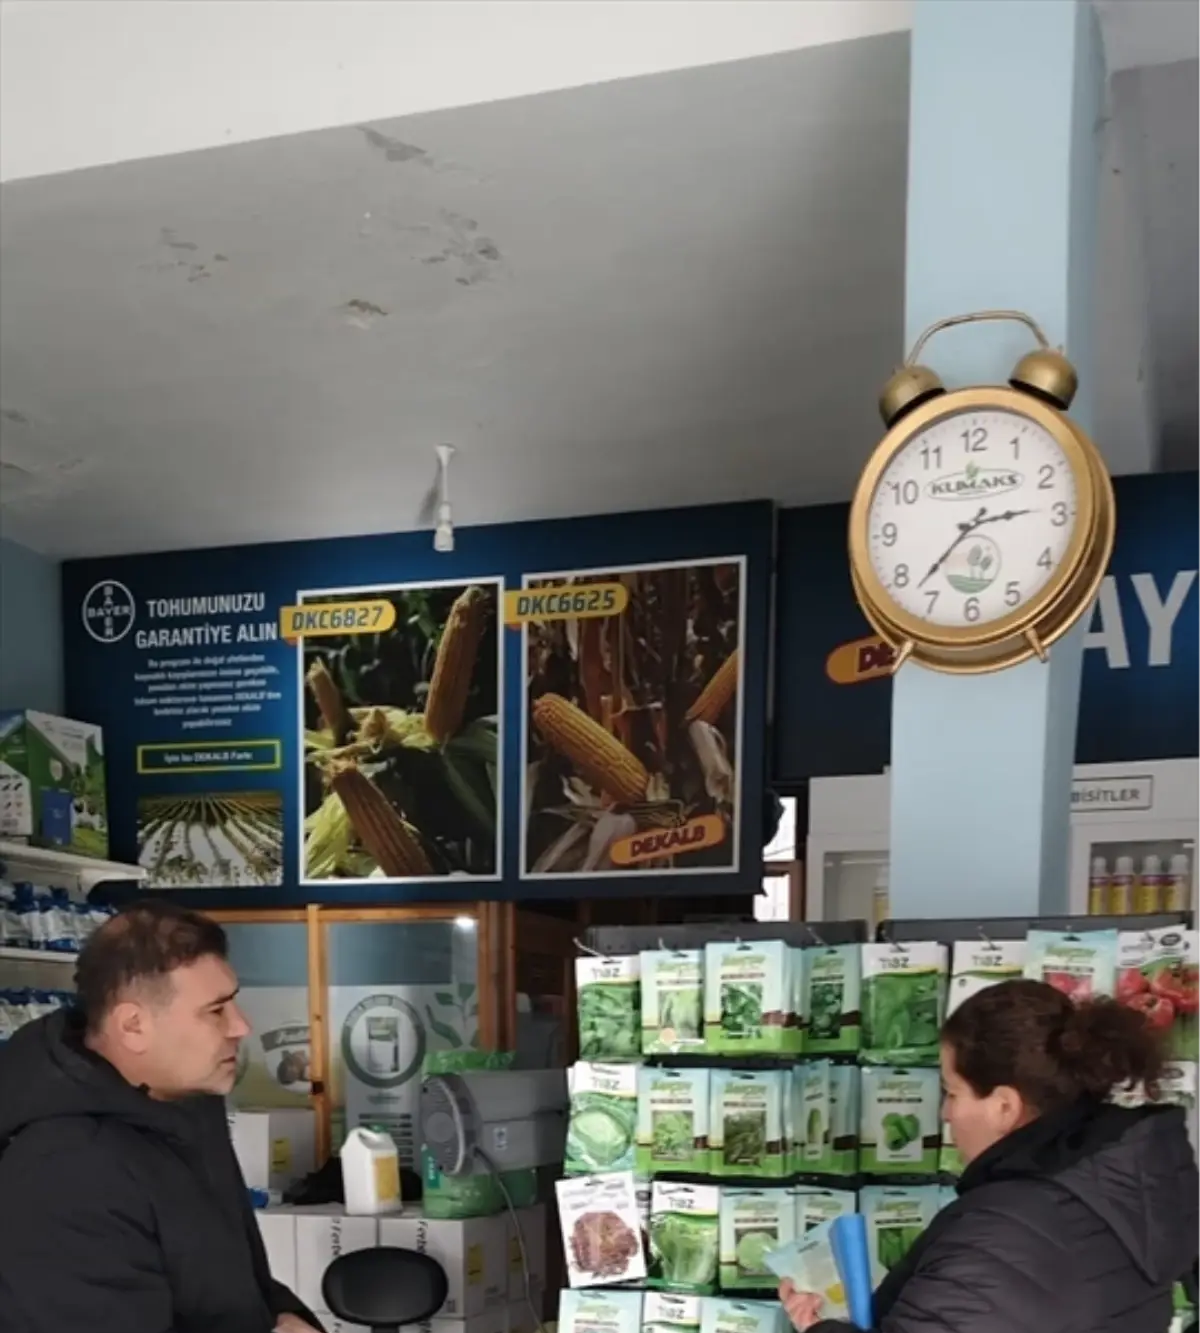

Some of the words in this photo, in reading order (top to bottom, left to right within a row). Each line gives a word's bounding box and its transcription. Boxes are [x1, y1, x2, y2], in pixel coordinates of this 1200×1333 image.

[960, 428, 989, 453] 12
[1009, 438, 1022, 461] 1
[920, 447, 943, 469] 11
[1038, 465, 1055, 490] 2
[891, 480, 920, 504] 10
[1050, 503, 1068, 527] 3
[882, 522, 898, 546] 9
[1036, 547, 1053, 570] 4
[893, 563, 909, 588] 8
[146, 593, 265, 619] TOHUMUNUZU
[516, 590, 617, 616] DKC6625
[923, 590, 940, 614] 7
[1004, 581, 1021, 606] 5
[87, 604, 132, 619] BAYER
[292, 605, 384, 632] DKC6827
[964, 597, 981, 622] 6
[135, 622, 232, 649] GARANTİYE
[236, 622, 278, 643] ALIN
[631, 825, 706, 858] DEKALB
